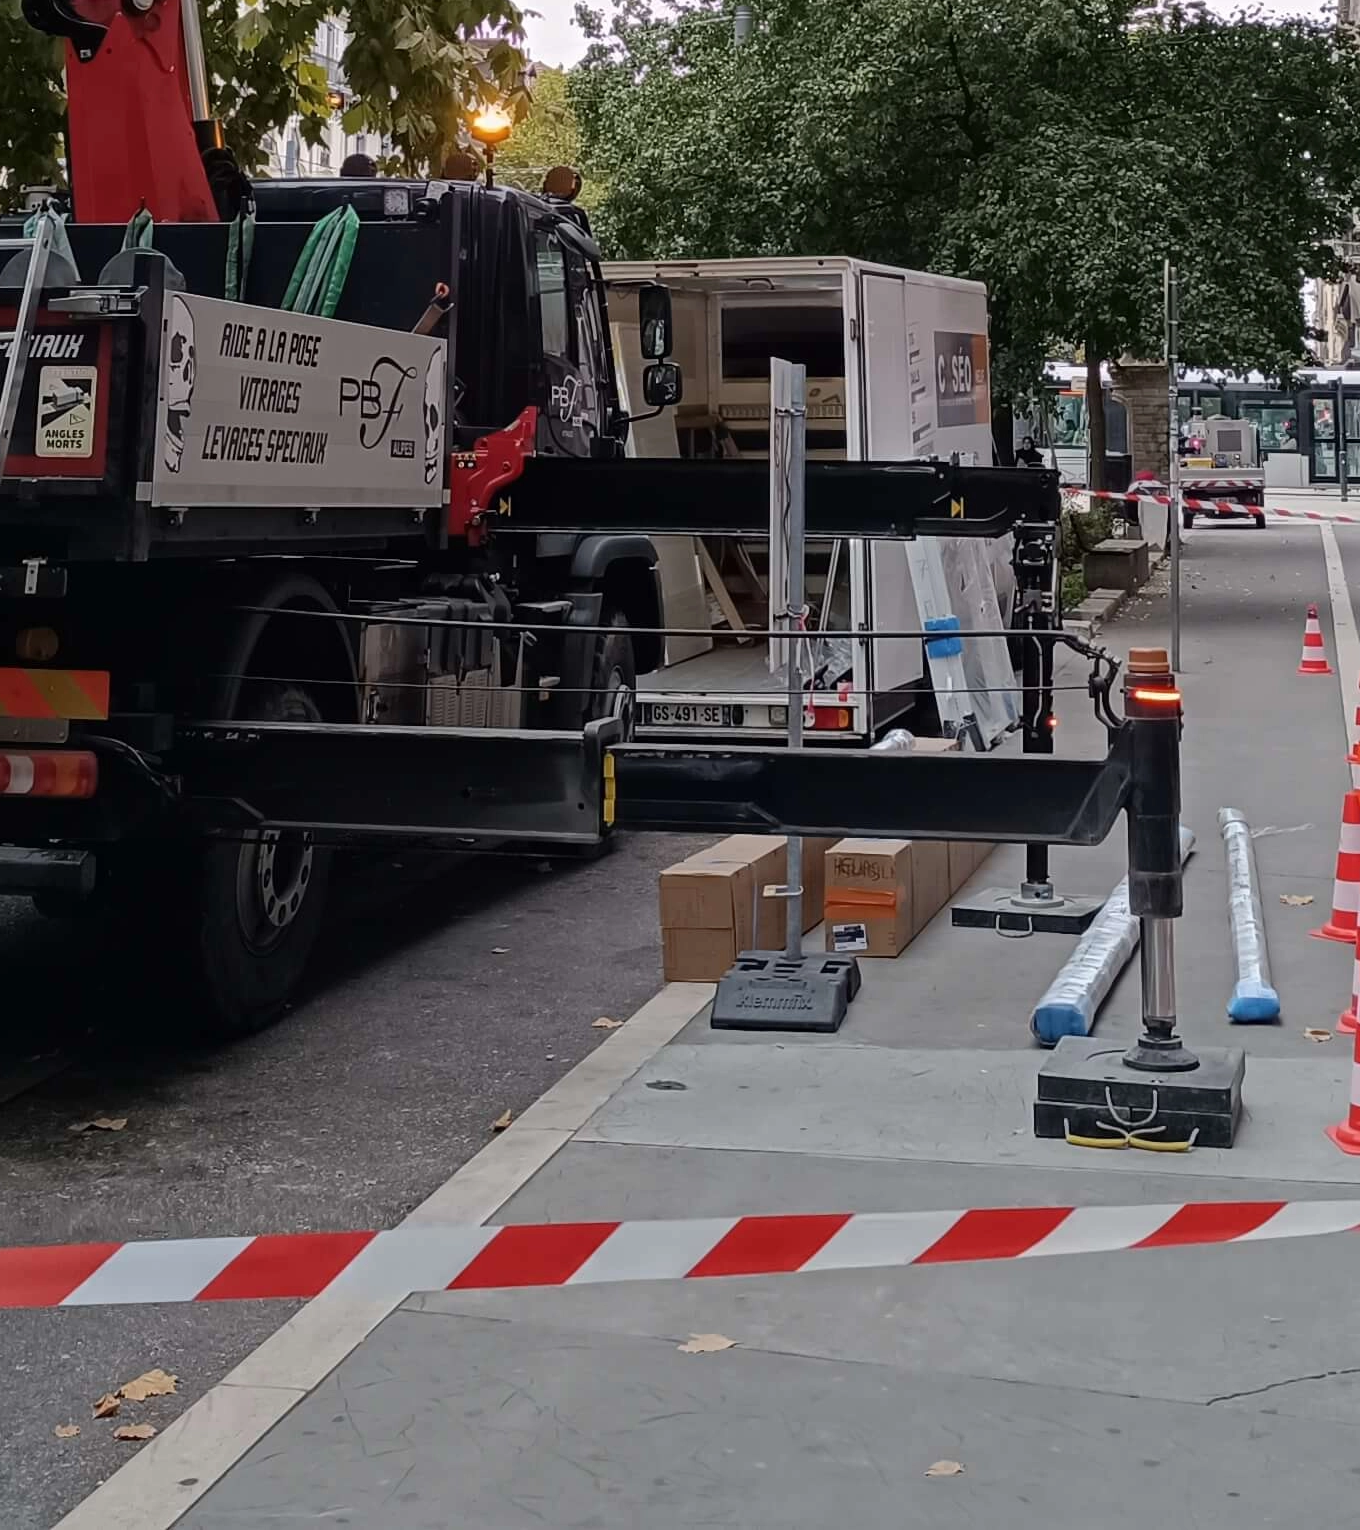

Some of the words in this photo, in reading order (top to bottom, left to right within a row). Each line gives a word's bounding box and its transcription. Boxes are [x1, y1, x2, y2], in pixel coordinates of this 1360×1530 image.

[220, 322, 254, 360] AIDE
[253, 328, 267, 362] A
[268, 329, 287, 364] LA
[287, 332, 322, 368] POSE
[240, 374, 302, 414] VITRAGES
[44, 429, 85, 439] ANGLES
[46, 439, 83, 449] MORTS
[201, 424, 265, 463] LEVAGES
[265, 429, 329, 465] SPECIAUX
[391, 440, 414, 457] ALPES
[653, 705, 720, 723] GS-491-SE
